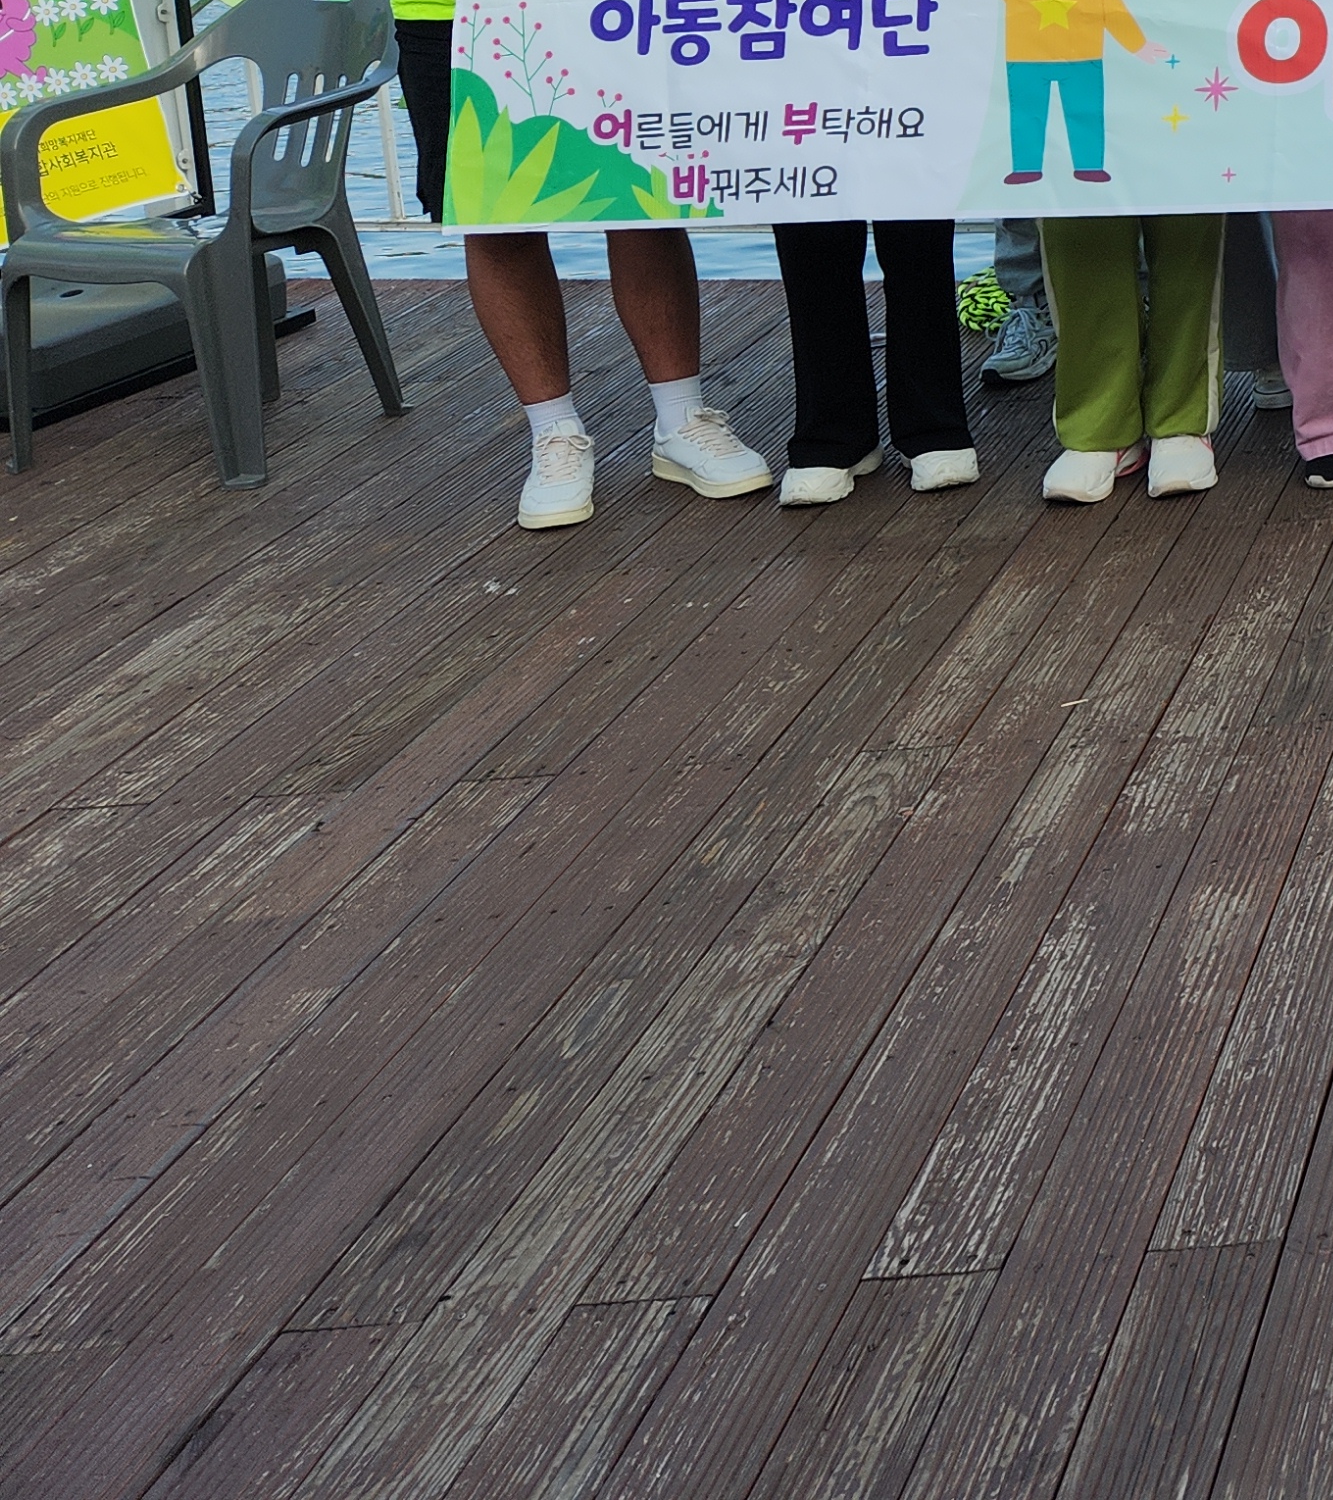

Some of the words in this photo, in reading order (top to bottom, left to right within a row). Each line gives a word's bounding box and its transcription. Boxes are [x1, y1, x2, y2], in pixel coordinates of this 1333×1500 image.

[39, 129, 97, 153] 희망복지재단
[593, 109, 769, 150] 어른들에게
[782, 102, 925, 145] 부탁해요
[60, 179, 100, 197] 지원으로
[673, 164, 838, 203] 바꿔주세요
